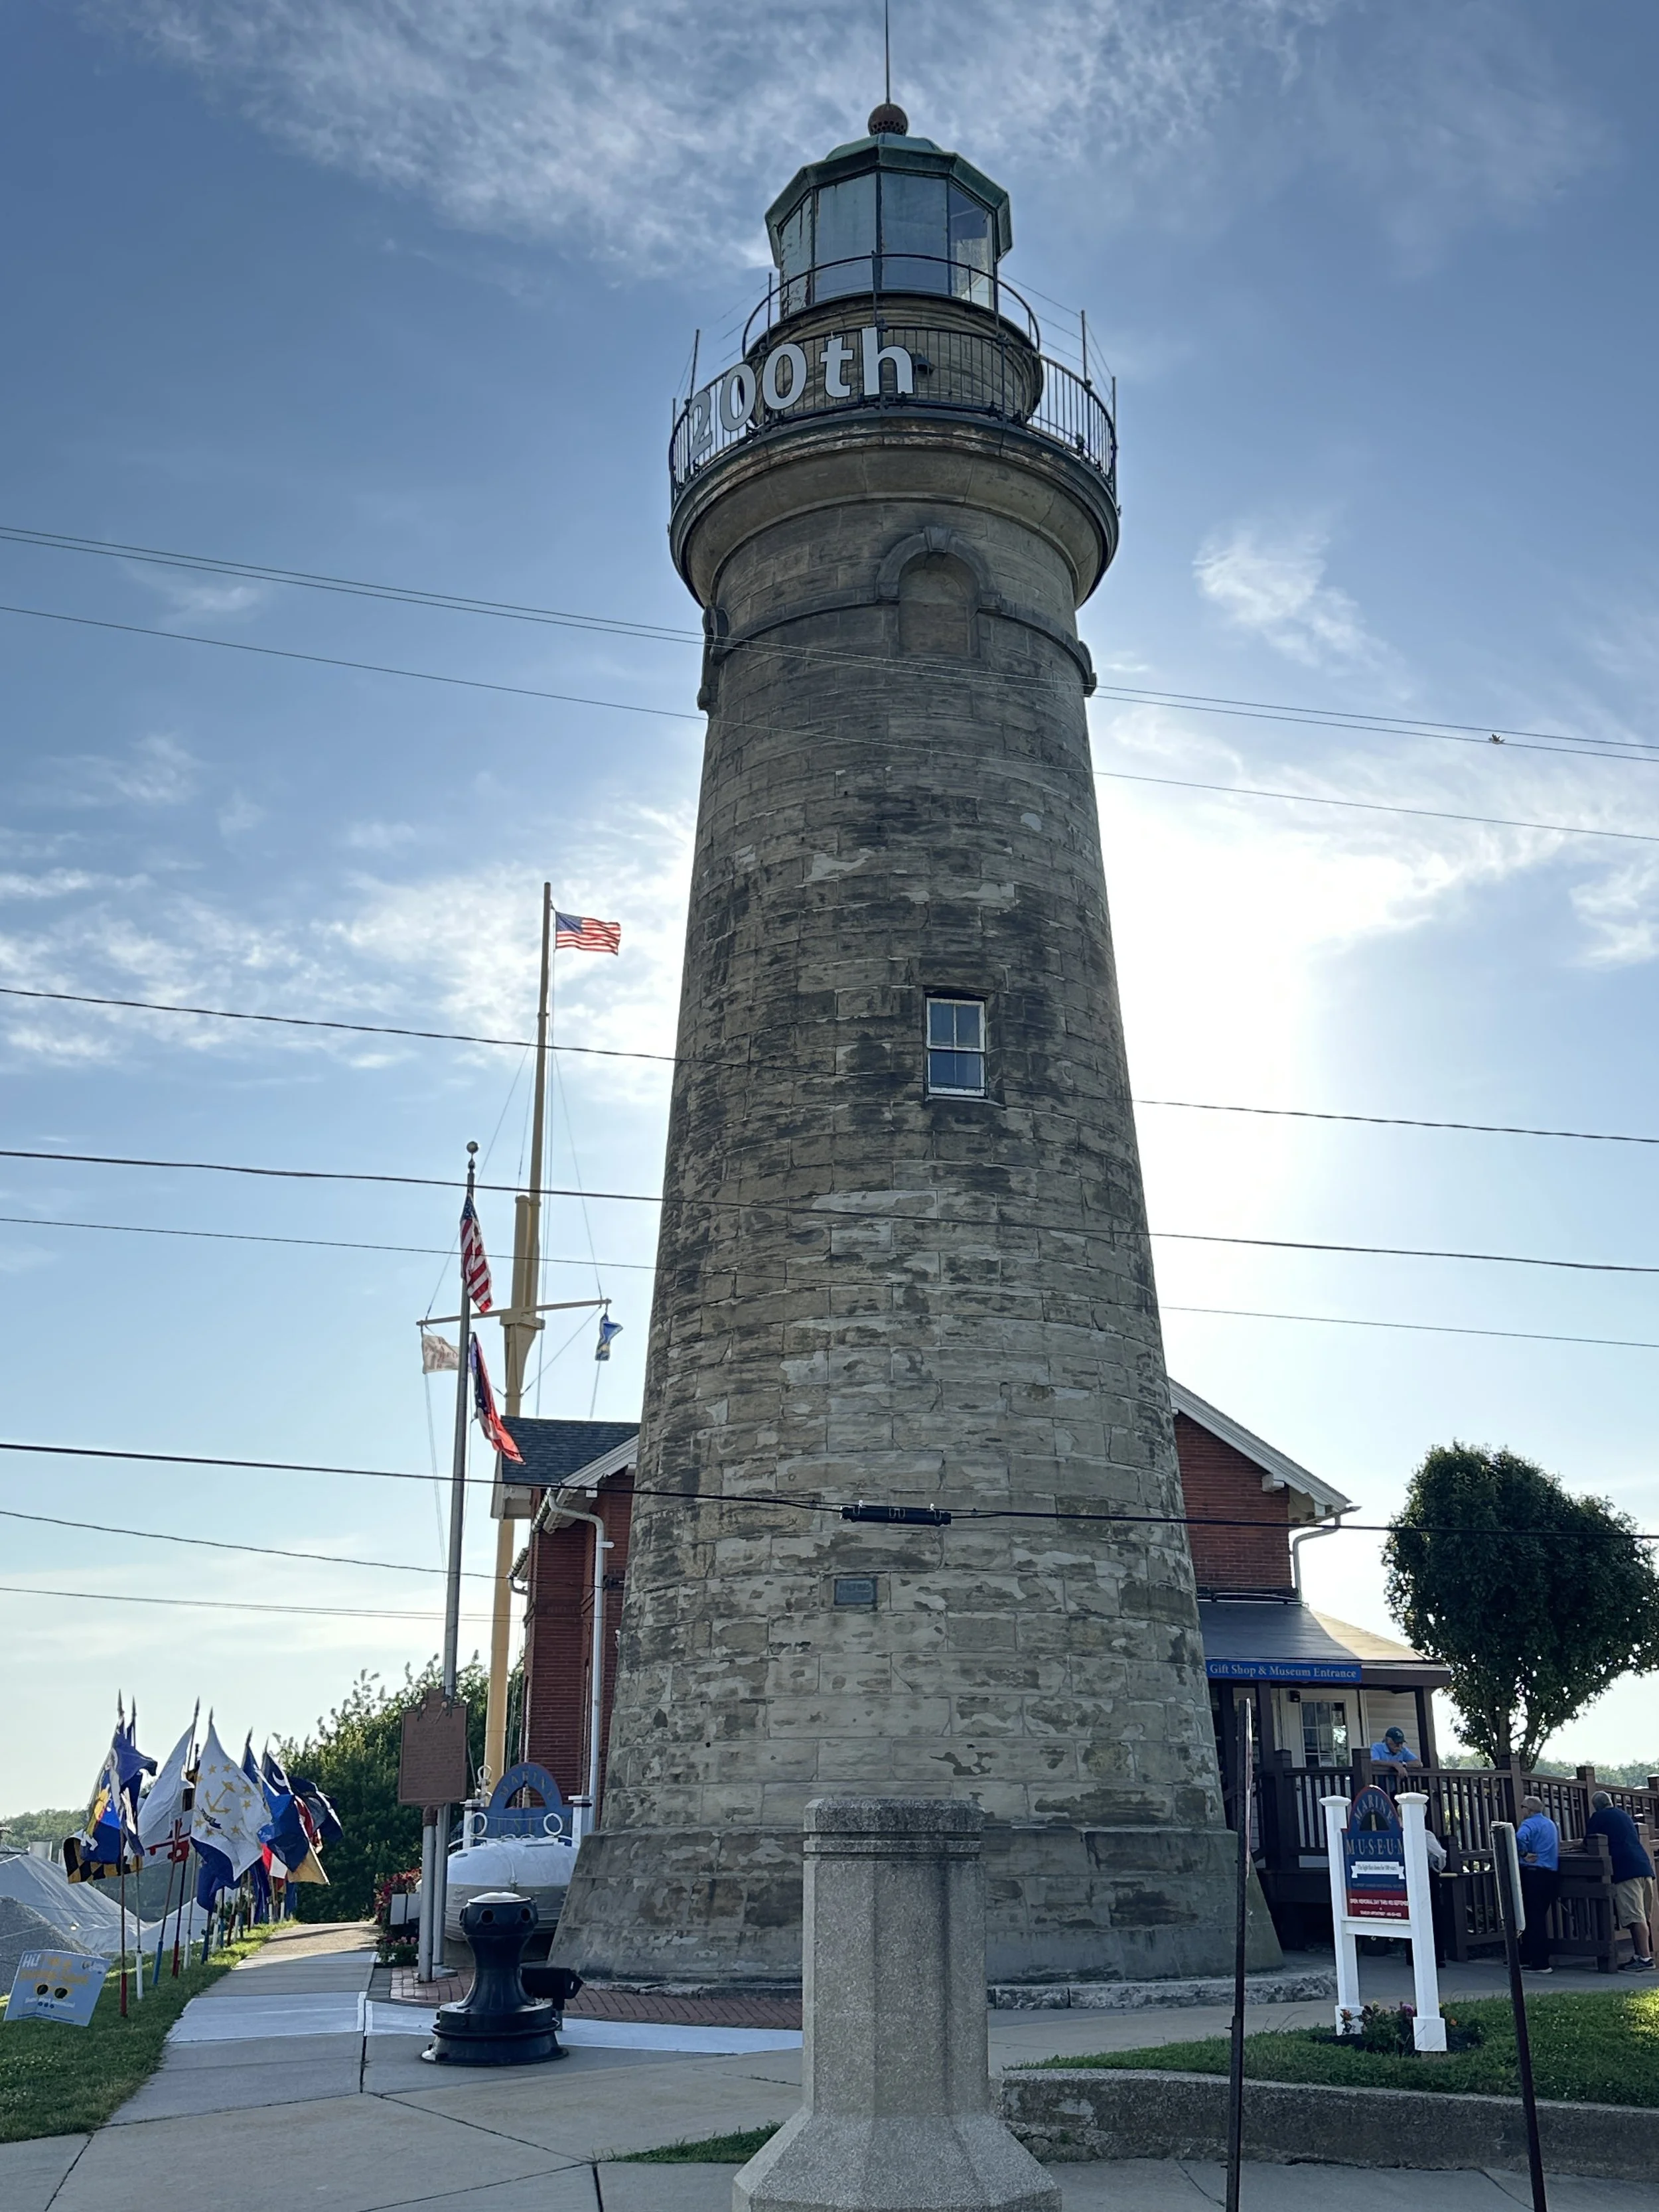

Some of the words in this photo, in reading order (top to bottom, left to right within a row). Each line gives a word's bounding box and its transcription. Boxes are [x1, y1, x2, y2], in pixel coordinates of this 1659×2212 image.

[689, 327, 914, 463] 200th
[1210, 1664, 1228, 1674] Gift
[1231, 1664, 1256, 1677] Shop
[1258, 1666, 1267, 1675] &
[1269, 1665, 1311, 1676] Museum
[1314, 1667, 1356, 1678] Entrance
[1354, 1795, 1394, 1824] MARINE
